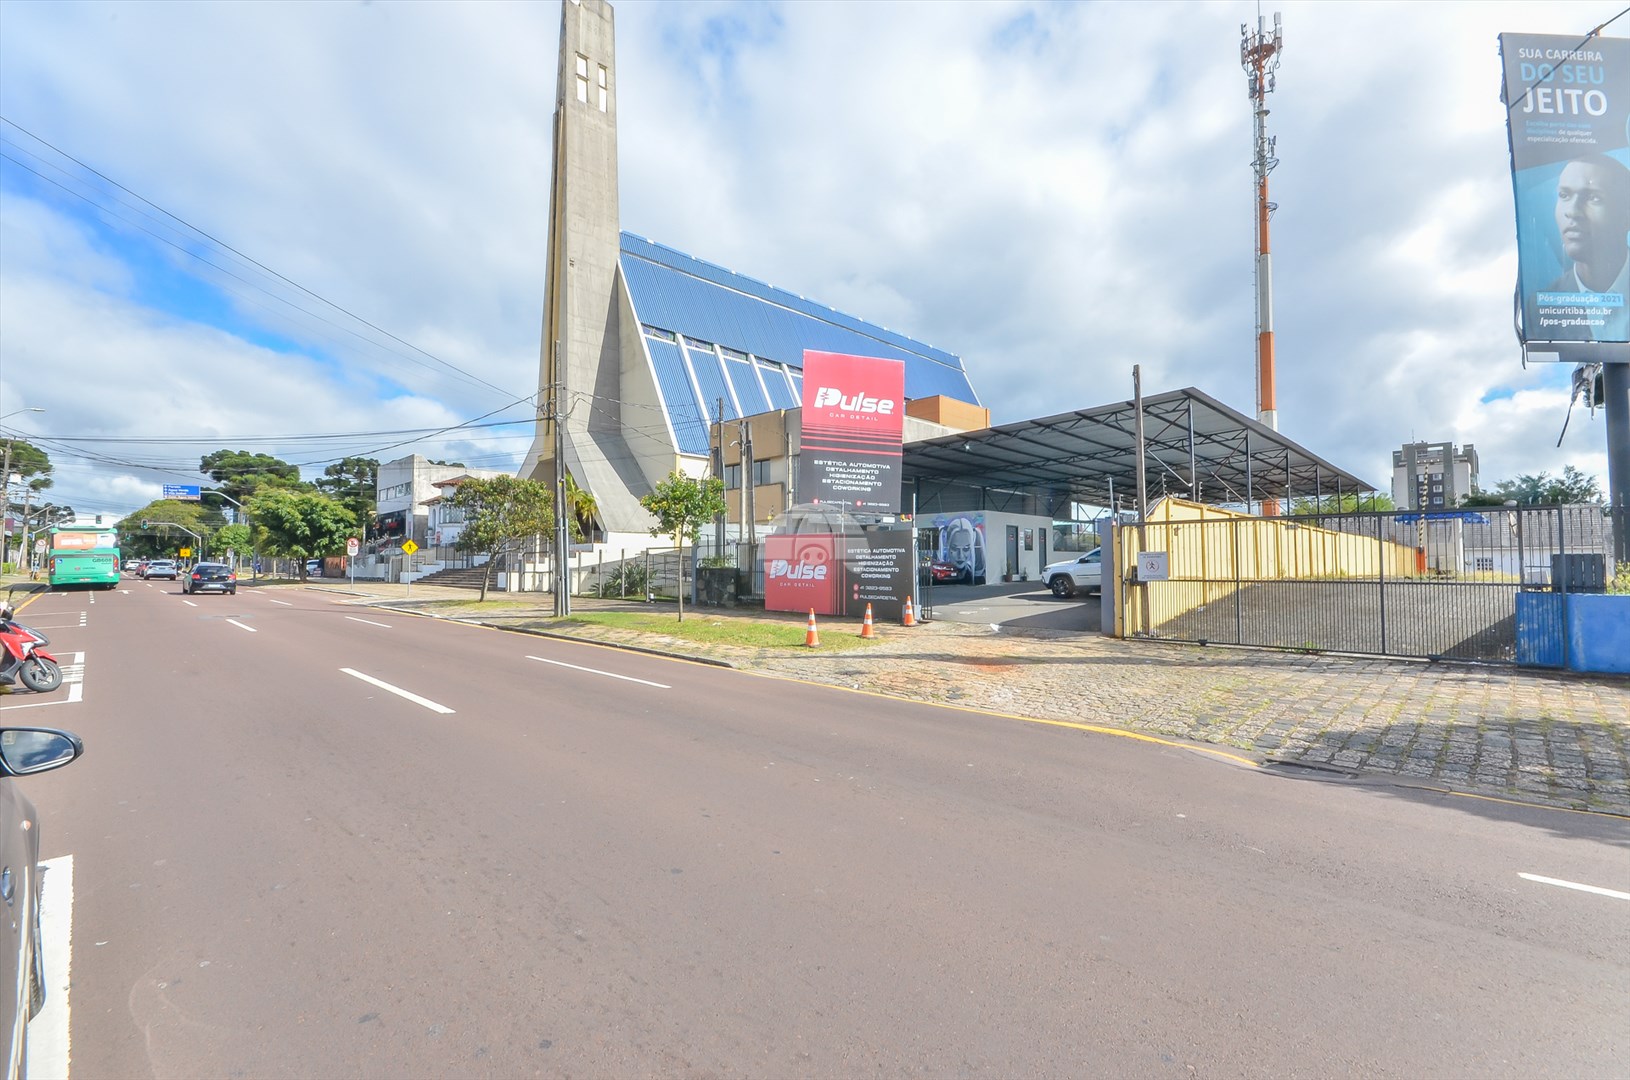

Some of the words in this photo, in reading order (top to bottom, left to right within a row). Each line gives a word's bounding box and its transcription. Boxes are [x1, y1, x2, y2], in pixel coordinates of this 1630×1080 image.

[1519, 48, 1543, 59] SUA
[1546, 49, 1603, 61] CARREIRA
[1520, 62, 1555, 82] DO
[1562, 64, 1604, 84] SEU
[1523, 87, 1608, 116] JEITO
[1538, 294, 1599, 304] Pós-graduação
[1601, 295, 1621, 303] 2021
[1539, 307, 1612, 315] unicuritiba.edu.br
[1539, 317, 1605, 327] /pos-graduacao
[814, 387, 894, 415] Pulse
[825, 466, 879, 475] DETALHAMENTO
[849, 461, 891, 470] AUTOMOTIVA
[822, 478, 882, 487] ESTACIONAMENTO
[769, 559, 827, 580] Pulse
